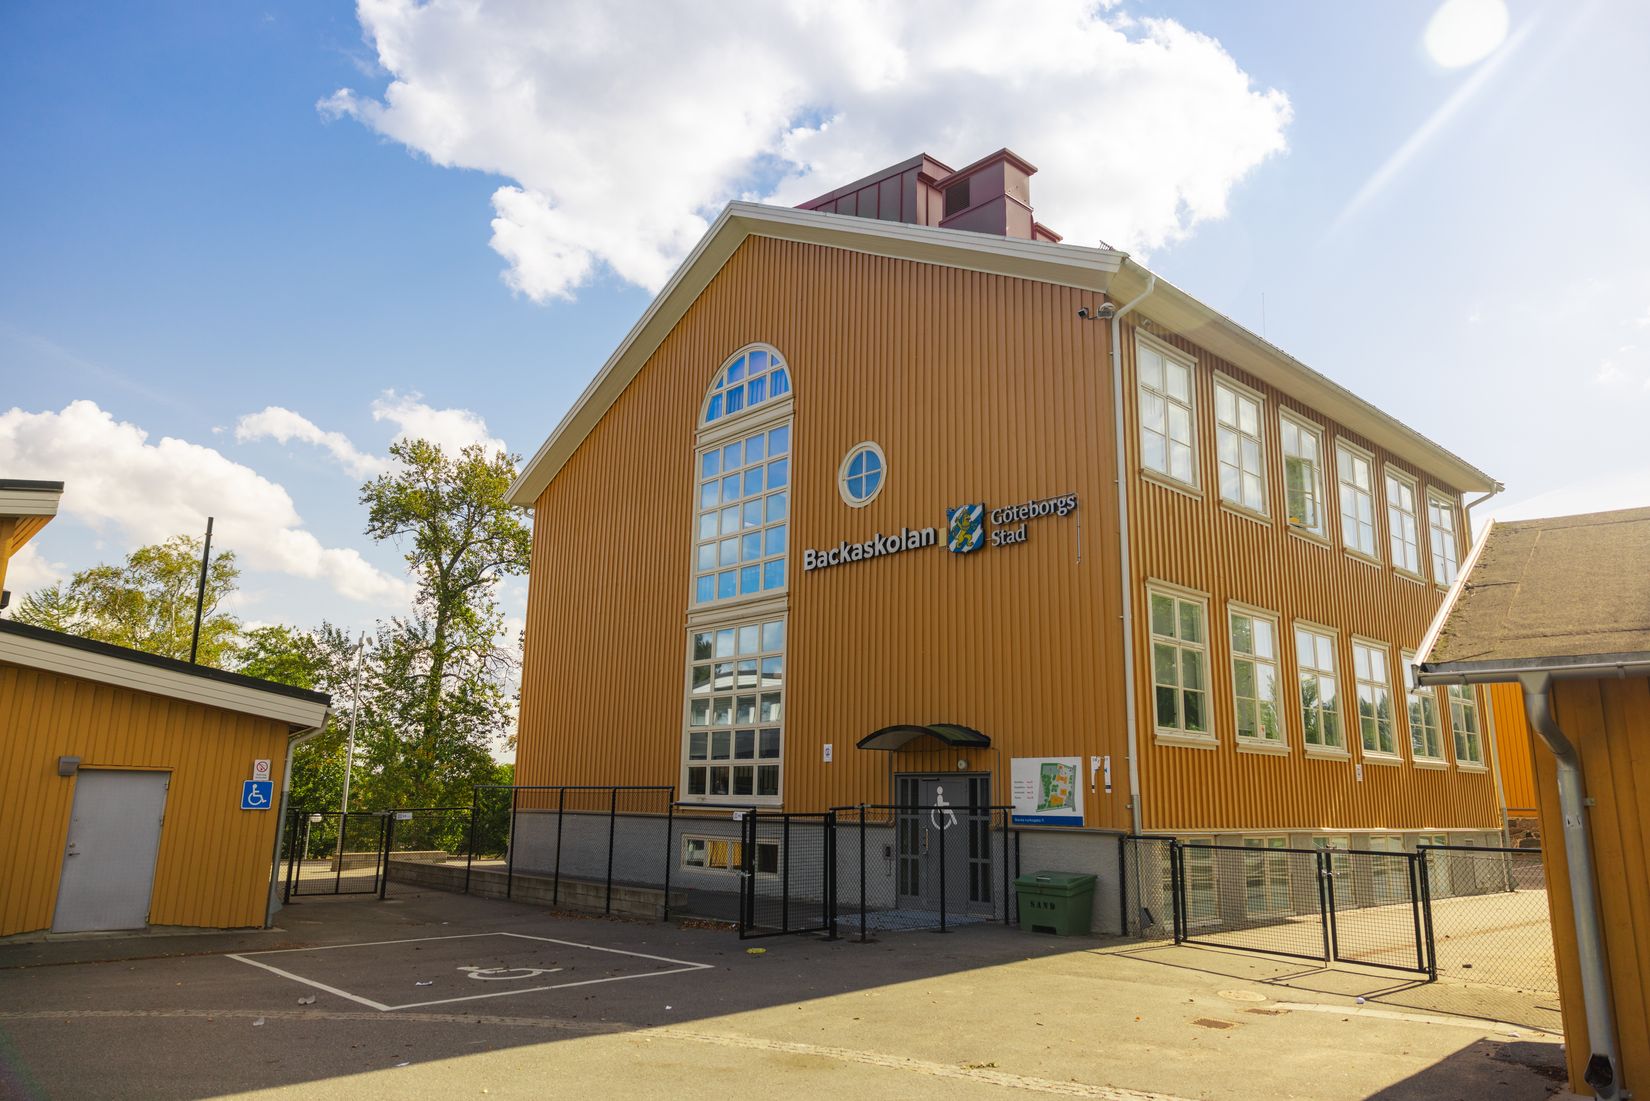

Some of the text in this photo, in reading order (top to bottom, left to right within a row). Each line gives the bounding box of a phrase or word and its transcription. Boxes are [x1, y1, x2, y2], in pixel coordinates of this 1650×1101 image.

[991, 494, 1076, 525] Göteborgs
[803, 526, 935, 571] Backaskolan
[991, 524, 1026, 547] Stad
[1030, 901, 1056, 911] SAND
